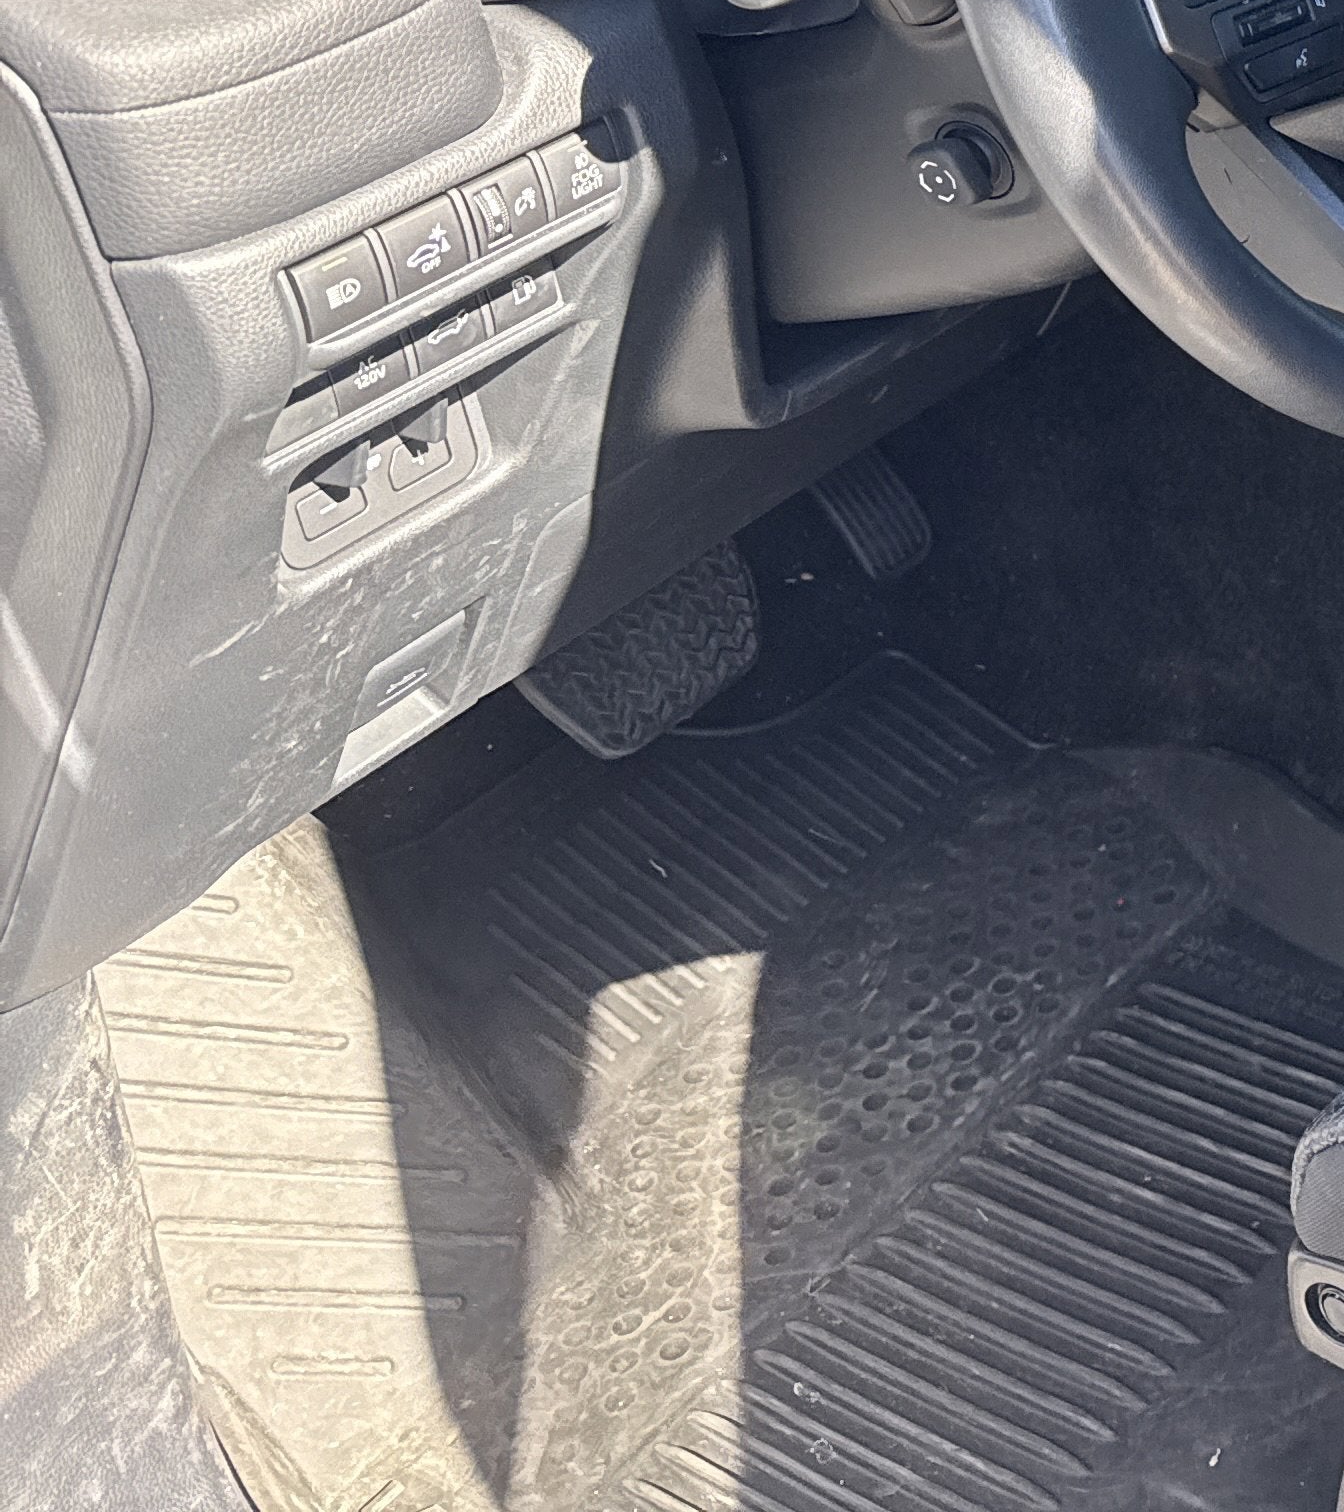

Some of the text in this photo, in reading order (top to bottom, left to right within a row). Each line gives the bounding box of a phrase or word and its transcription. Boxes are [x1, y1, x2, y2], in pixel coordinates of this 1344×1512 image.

[572, 163, 600, 187] FOG
[421, 256, 441, 274] OFF
[358, 355, 378, 375] AC
[353, 364, 386, 390] 120V
